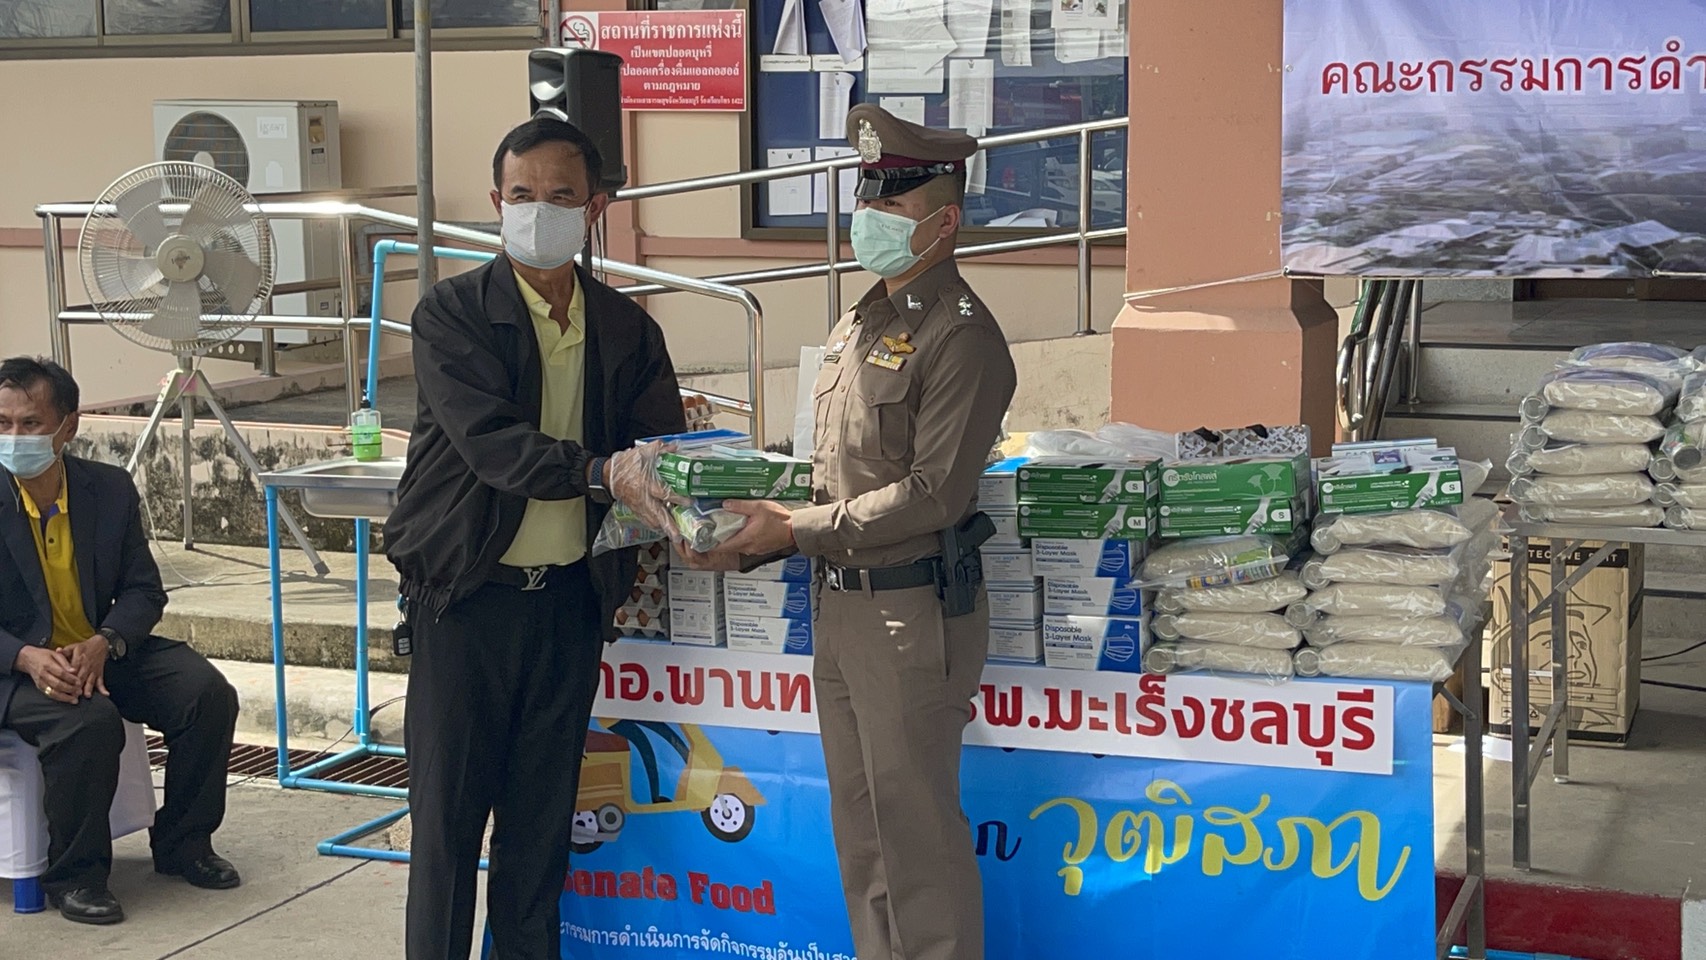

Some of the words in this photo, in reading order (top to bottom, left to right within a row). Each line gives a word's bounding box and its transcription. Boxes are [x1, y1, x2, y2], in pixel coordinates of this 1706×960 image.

[600, 13, 743, 39] สถานที่ราชการแห่งนี้
[630, 41, 713, 61] เป็นเขตปลอดบุหรี่
[643, 81, 701, 93] ตามกฎหมาย
[800, 475, 806, 484] S
[1132, 483, 1139, 491] S
[1045, 624, 1082, 633] Disposable
[1045, 633, 1071, 642] 3-Layer
[1072, 634, 1092, 642] Mask
[969, 674, 1375, 766] พ.มะเร็งชลบุรี
[968, 815, 1022, 861] ก
[1029, 779, 1411, 901] วุฒิสภา
[687, 870, 776, 915] Food
[560, 921, 858, 960] ะกรรมการดำเนินการจัดกิจกรรมอันเป็นส
